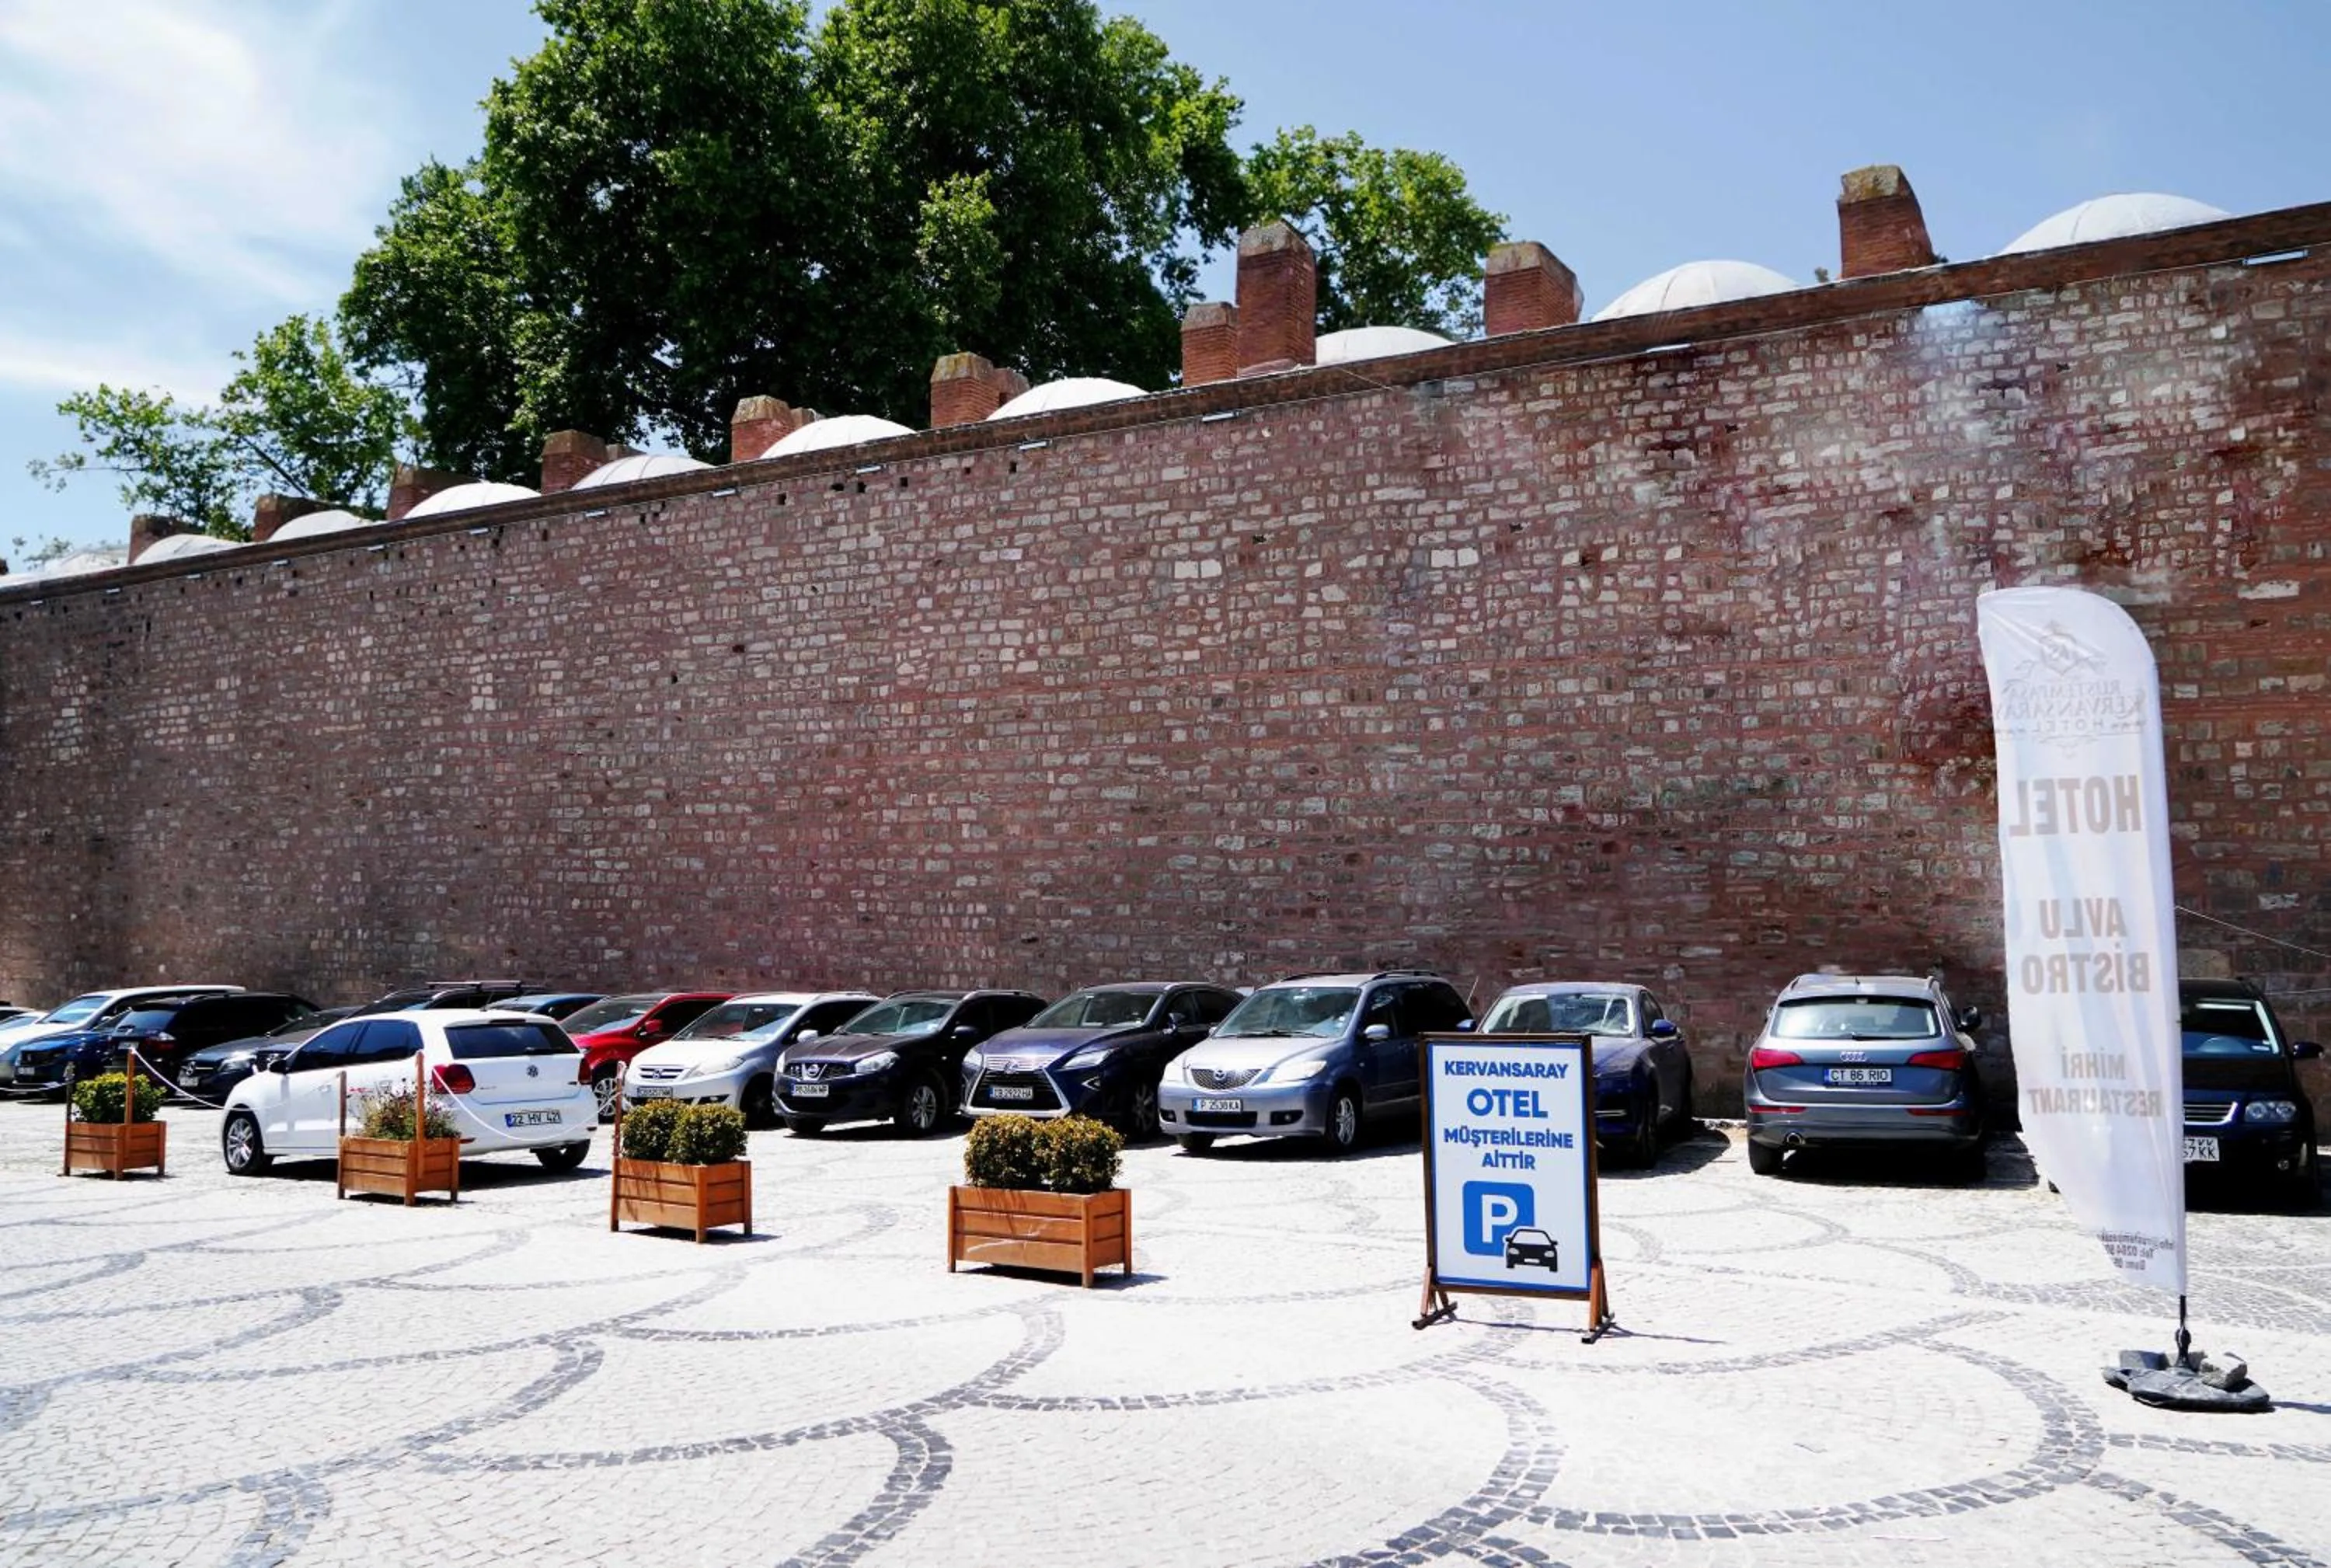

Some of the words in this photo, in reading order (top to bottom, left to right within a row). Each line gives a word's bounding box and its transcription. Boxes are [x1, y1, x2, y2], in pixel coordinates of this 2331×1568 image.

[1444, 1061, 1569, 1079] KERVANSARAY
[1831, 1070, 1845, 1081] CT
[1850, 1070, 1864, 1081] 86
[1466, 1088, 1549, 1119] OTEL
[1444, 1126, 1573, 1149] MÜŞTERİLERİNE
[1482, 1149, 1536, 1170] AİTTİR
[1481, 1193, 1518, 1244] P
